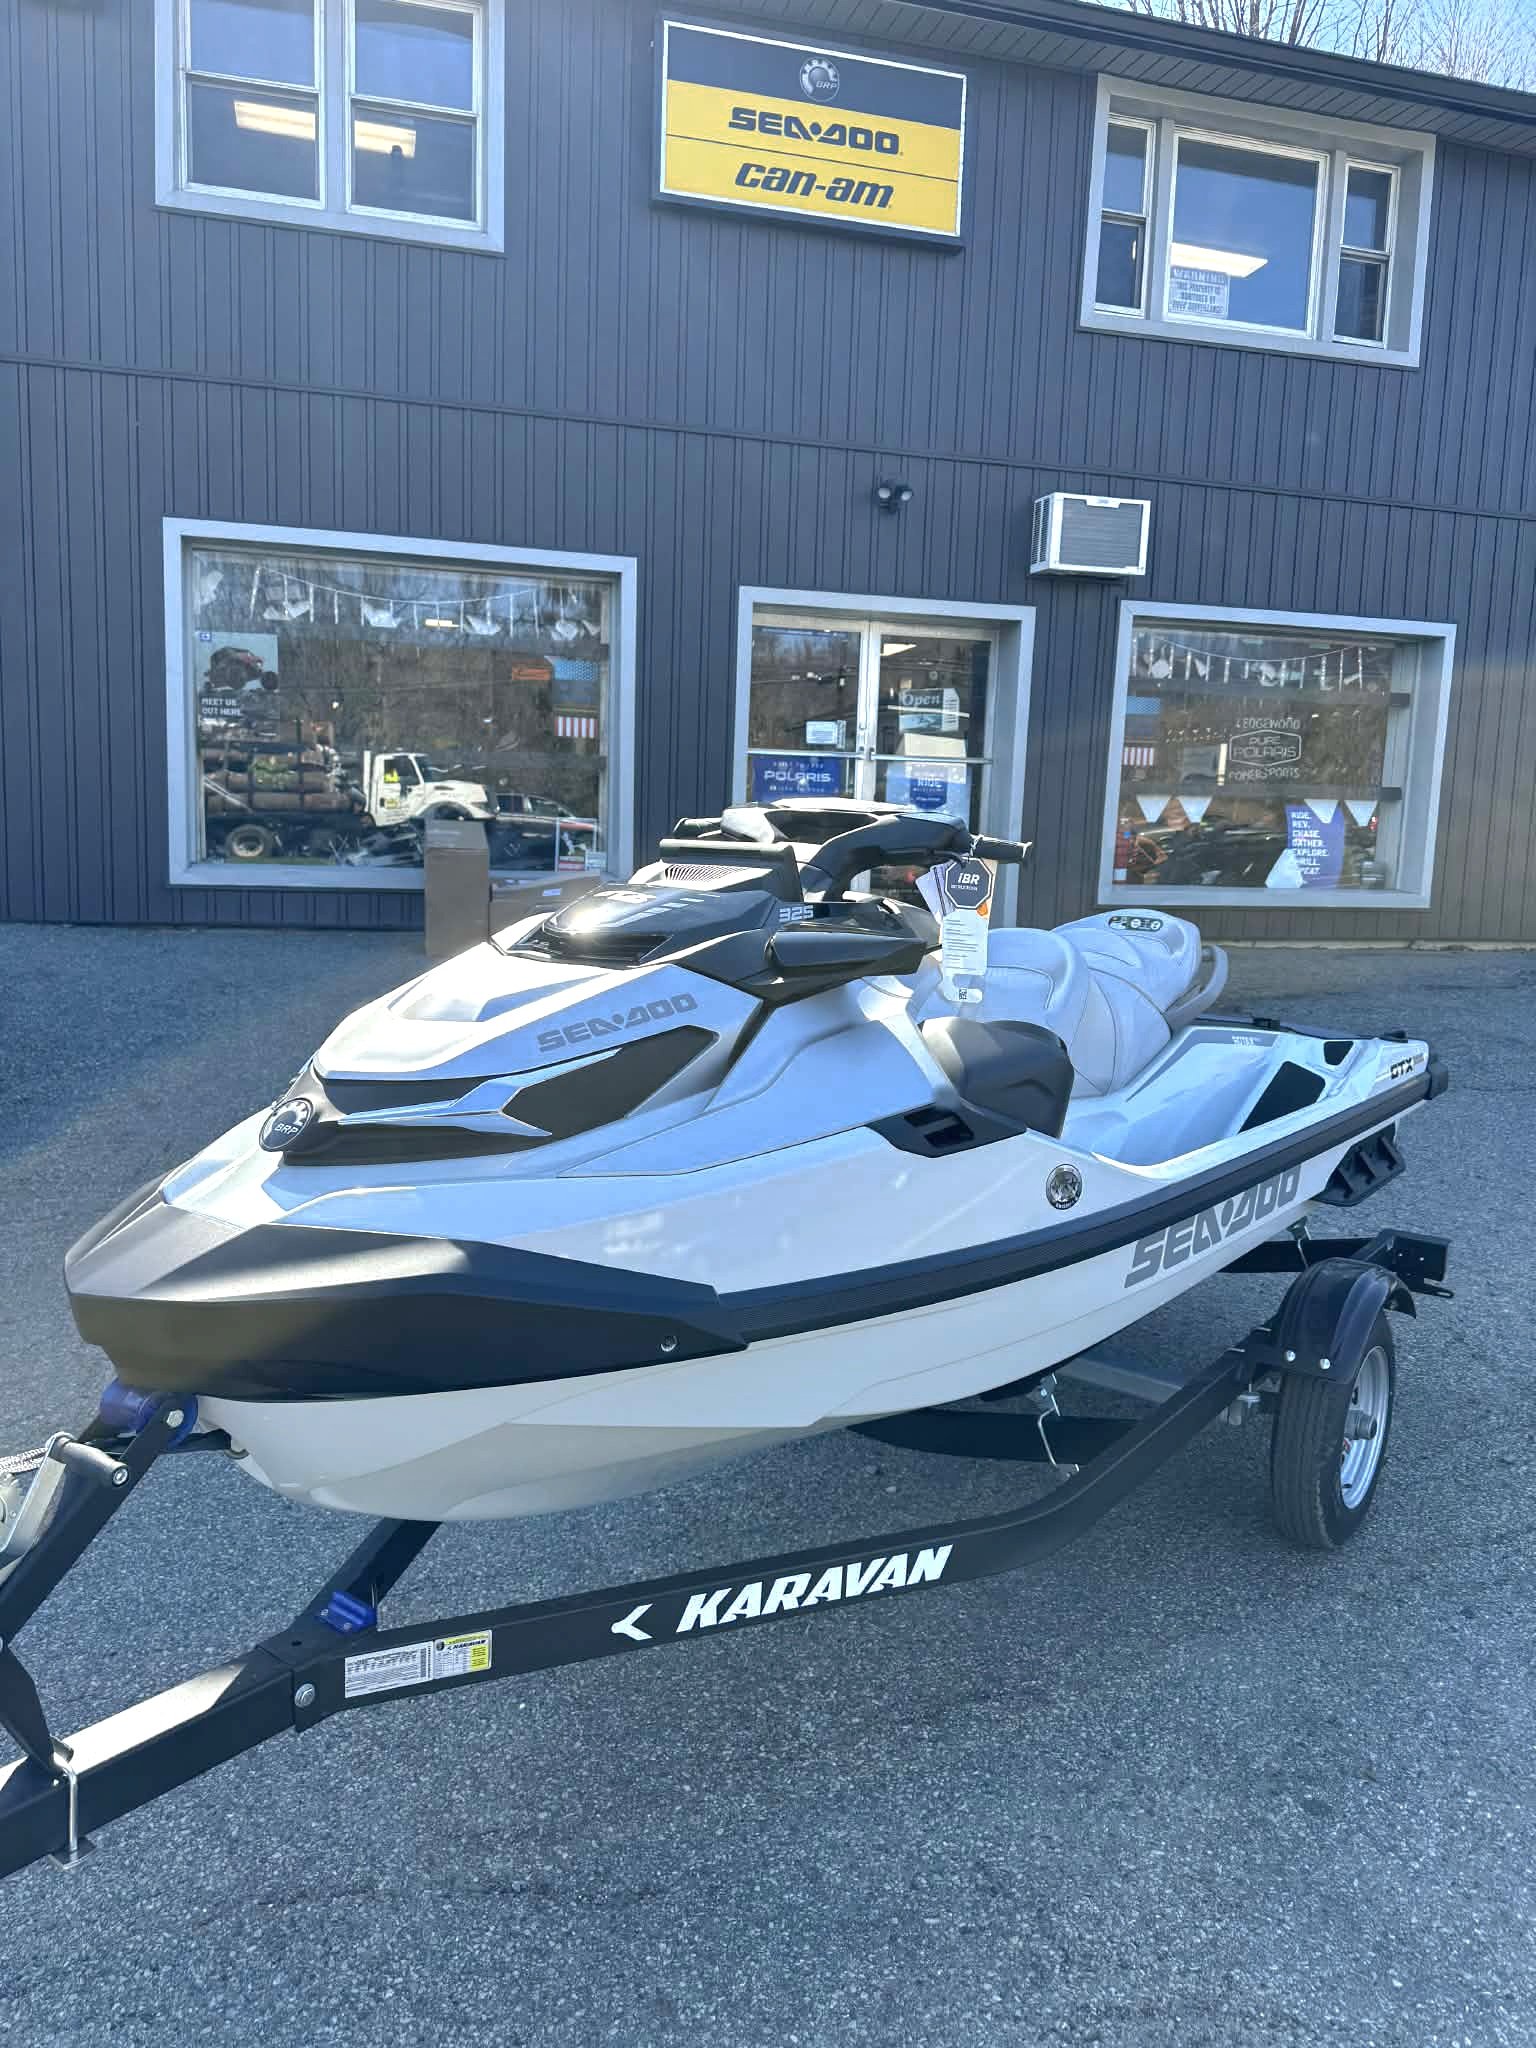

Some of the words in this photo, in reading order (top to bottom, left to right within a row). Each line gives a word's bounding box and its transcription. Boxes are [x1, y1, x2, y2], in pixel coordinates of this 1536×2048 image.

[735, 162, 894, 209] can-am
[902, 693, 940, 708] Open
[1233, 746, 1297, 759] POLARIS
[764, 770, 832, 783] POLARIS
[1391, 1056, 1413, 1080] GTX
[275, 1122, 299, 1135] BRP
[675, 1544, 953, 1633] KARAVAN
